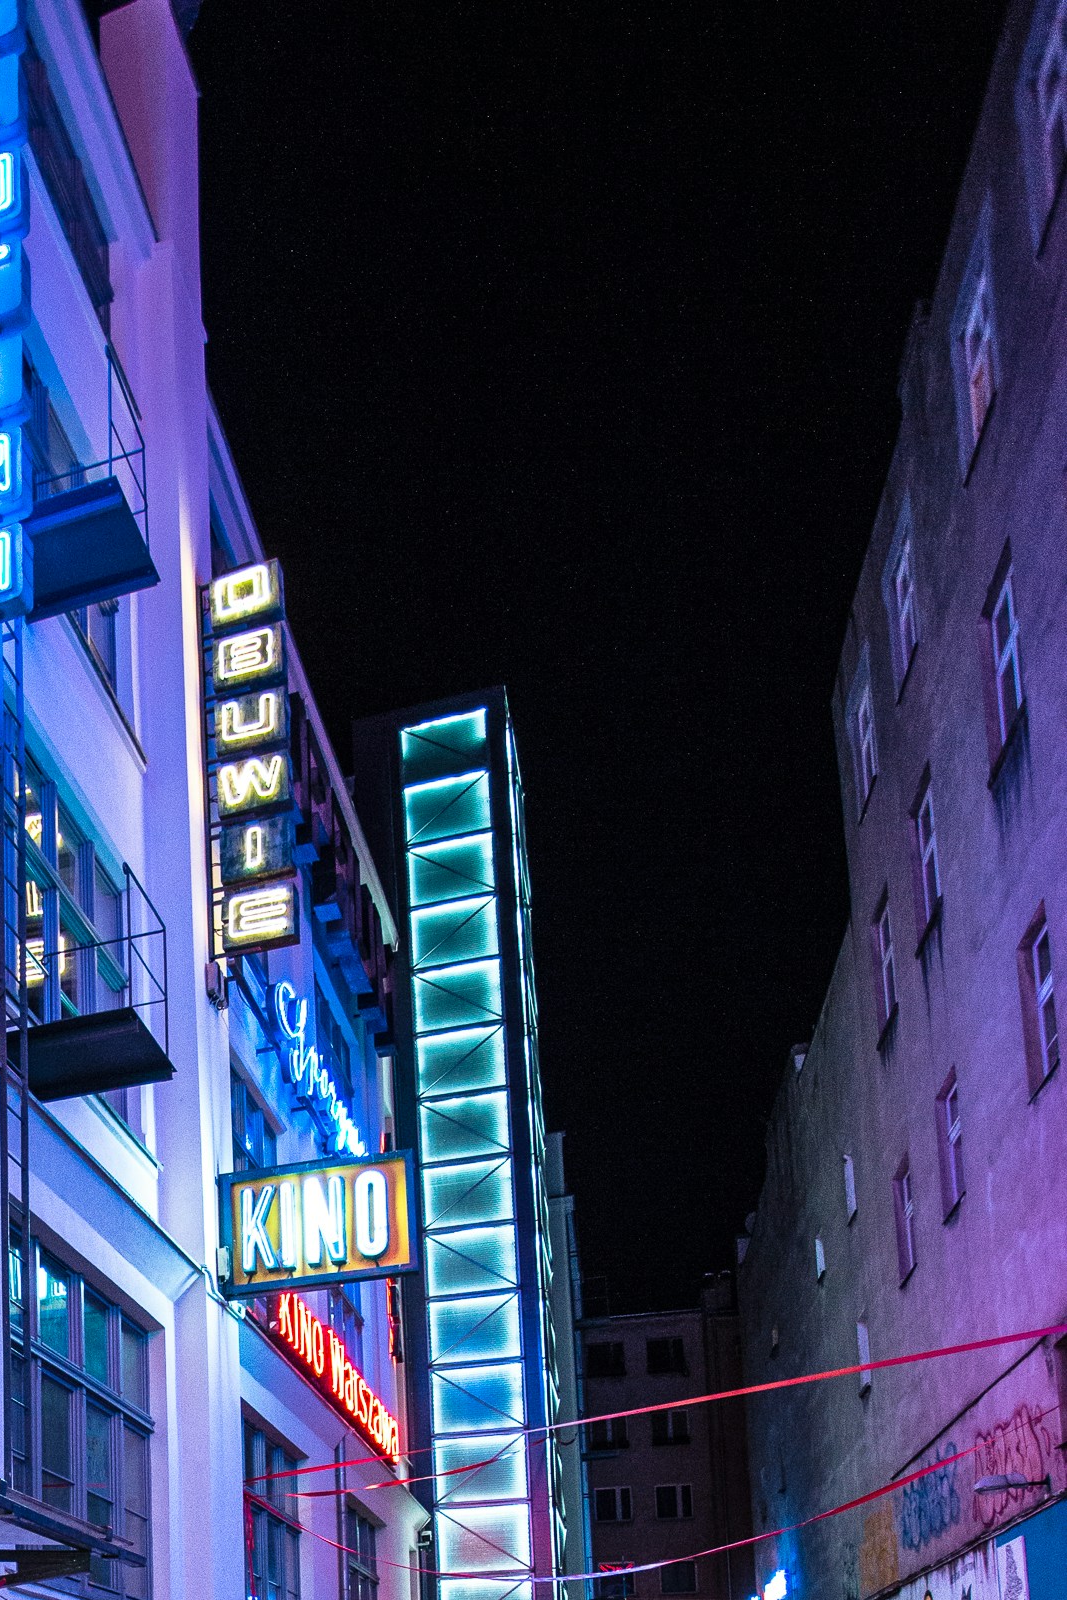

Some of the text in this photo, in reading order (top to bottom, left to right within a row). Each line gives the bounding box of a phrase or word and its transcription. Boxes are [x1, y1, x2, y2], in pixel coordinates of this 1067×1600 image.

[213, 563, 288, 939] OBUWIE
[243, 1169, 390, 1272] KINO
[279, 1292, 325, 1378] KINO
